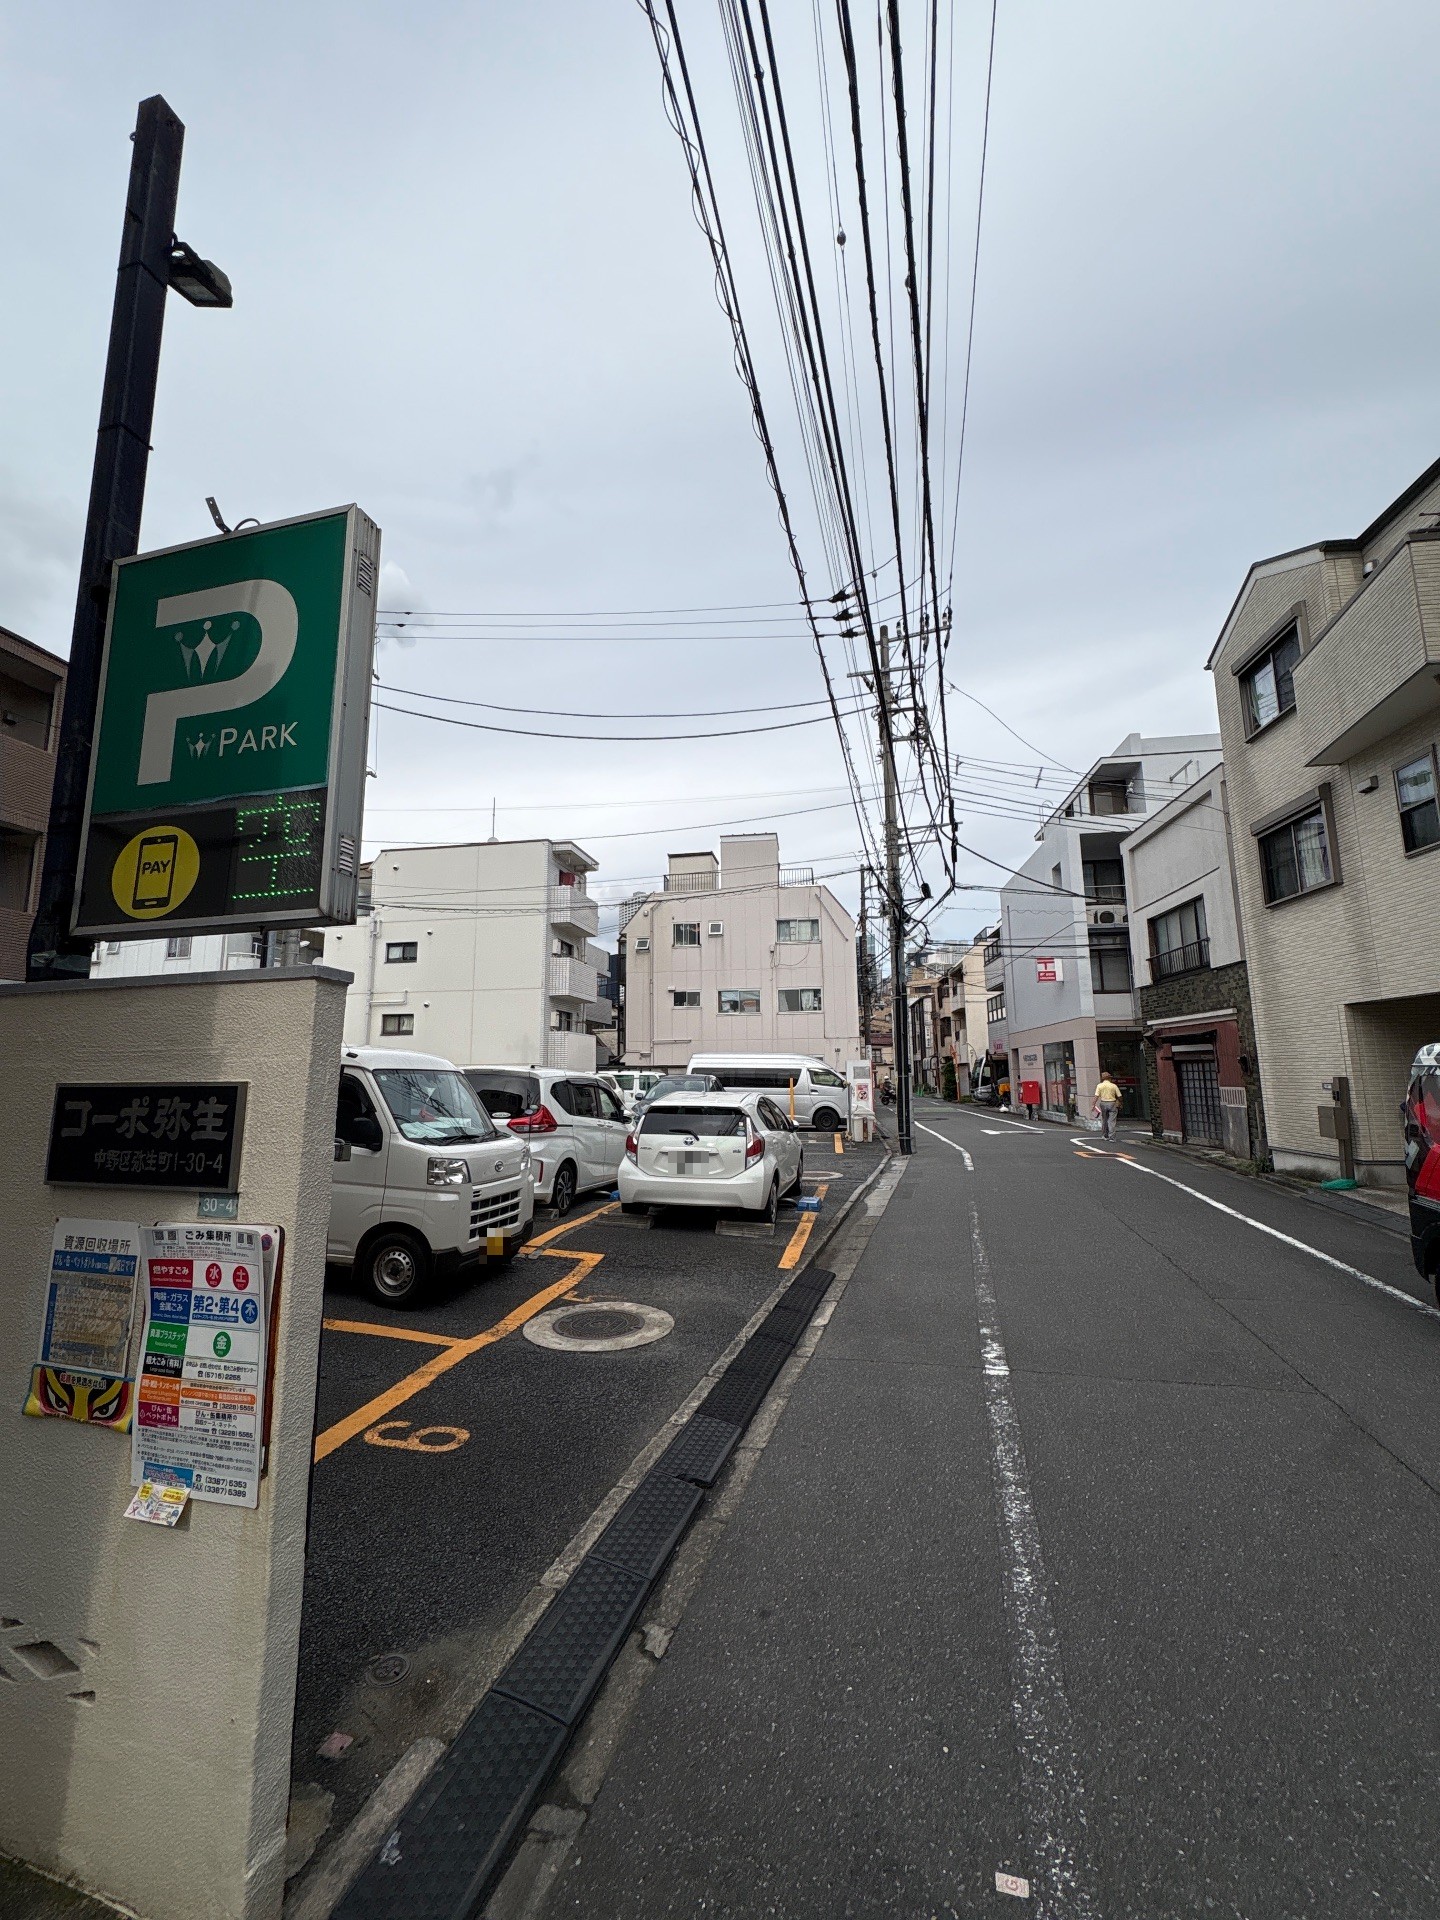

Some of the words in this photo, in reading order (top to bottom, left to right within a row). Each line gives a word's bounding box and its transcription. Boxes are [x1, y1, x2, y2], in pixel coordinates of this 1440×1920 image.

[218, 721, 299, 757] PARK
[232, 795, 321, 900] 空
[141, 859, 171, 876] PAY
[60, 1095, 229, 1142] コーポ弥生
[94, 1149, 223, 1174] 中野区弥生町1-30-4
[202, 1197, 233, 1213] 30-4
[64, 1235, 132, 1254] 資源回収場所
[185, 1230, 232, 1243] ごみ集積所
[209, 1265, 219, 1280] 水
[235, 1269, 246, 1283] 土
[244, 1301, 256, 1317] 木
[216, 1335, 228, 1350] 金
